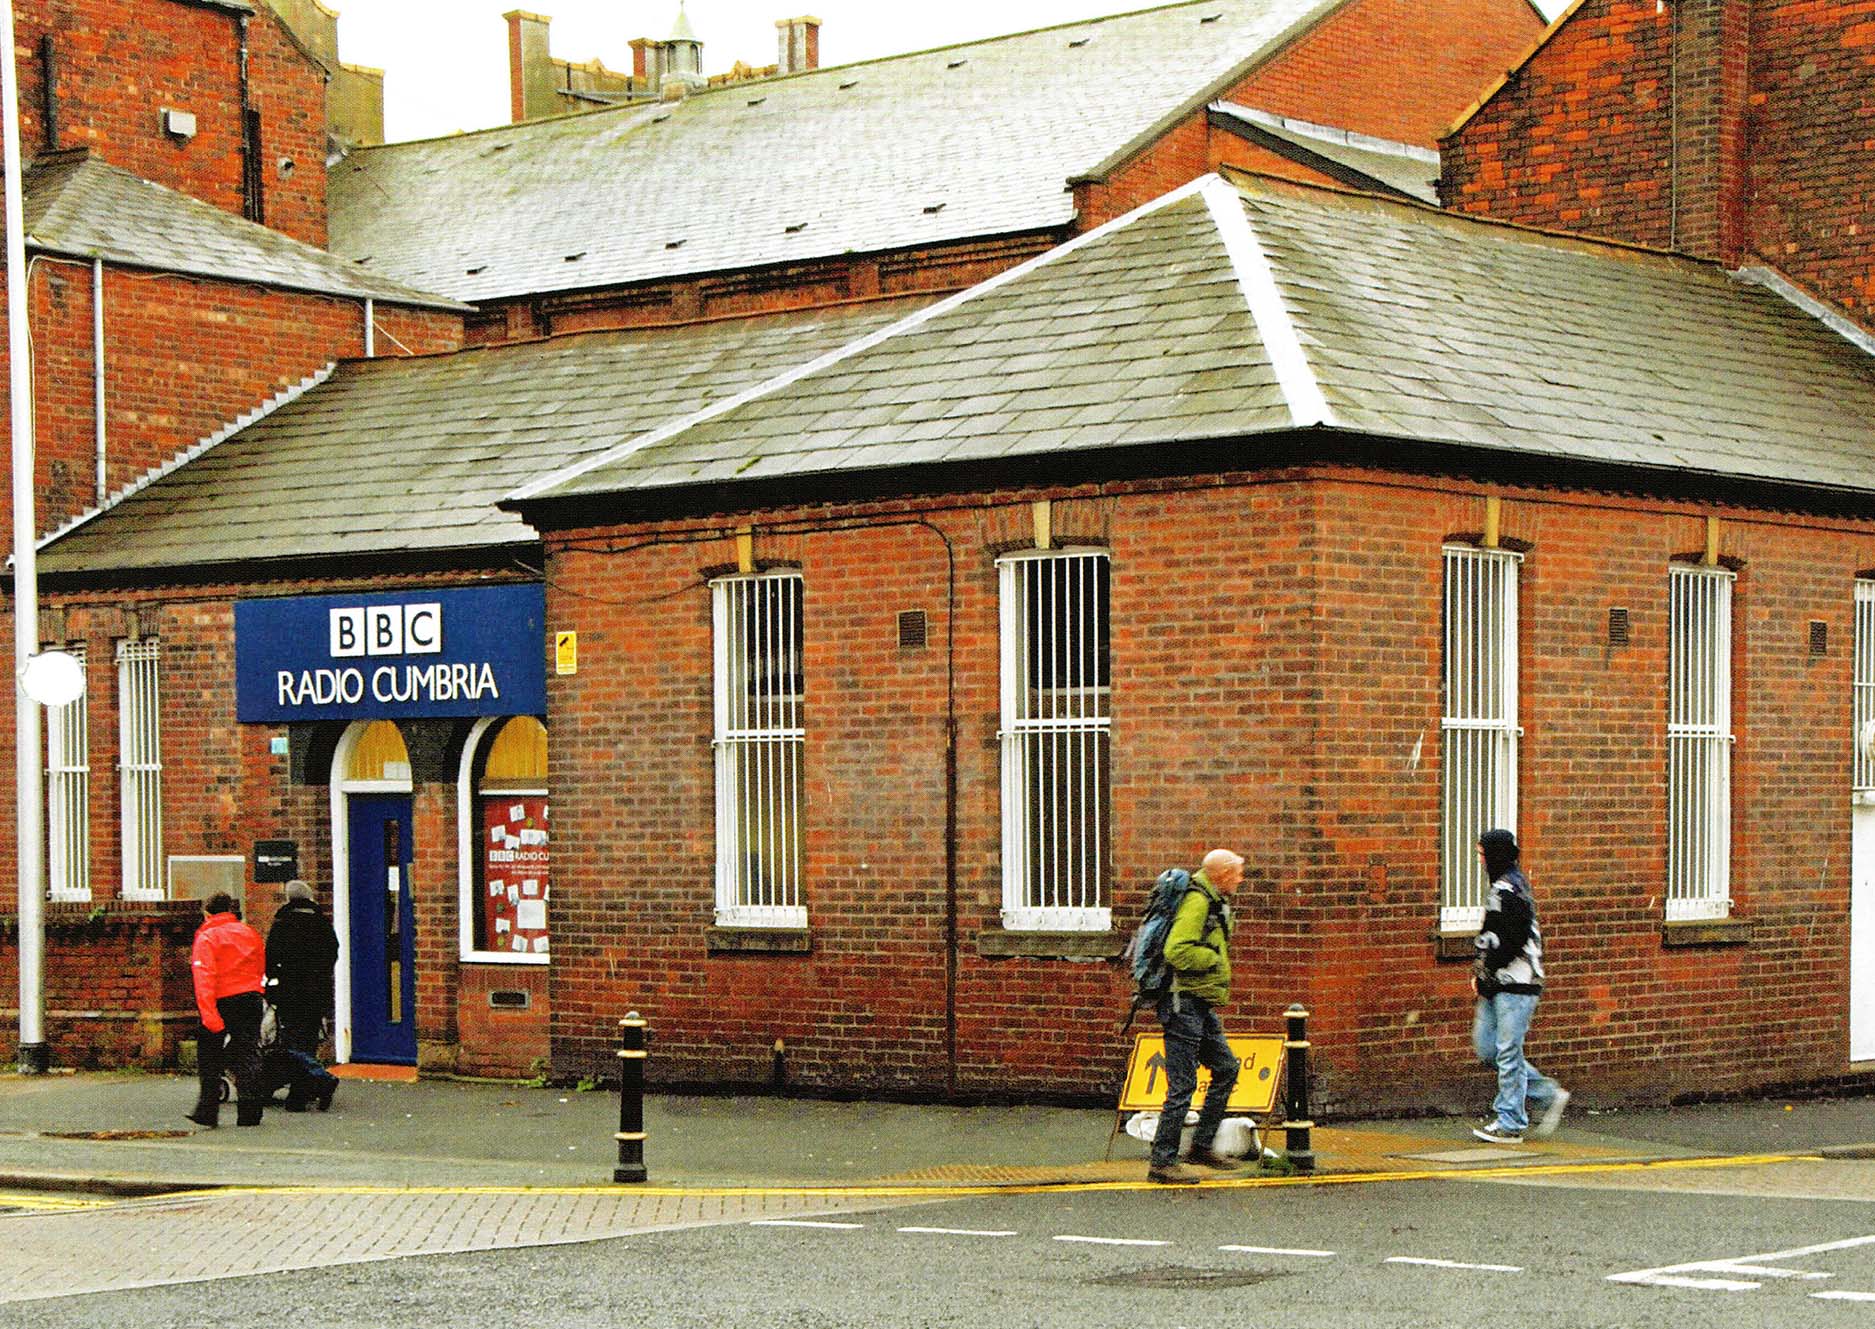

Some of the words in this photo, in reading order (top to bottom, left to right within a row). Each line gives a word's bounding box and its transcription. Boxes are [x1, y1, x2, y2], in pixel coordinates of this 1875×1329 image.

[338, 610, 434, 651] BBC
[277, 667, 364, 706] RADIO
[371, 662, 499, 703] CUMBRIA
[490, 850, 514, 862] BBC
[515, 851, 538, 861] RADIO
